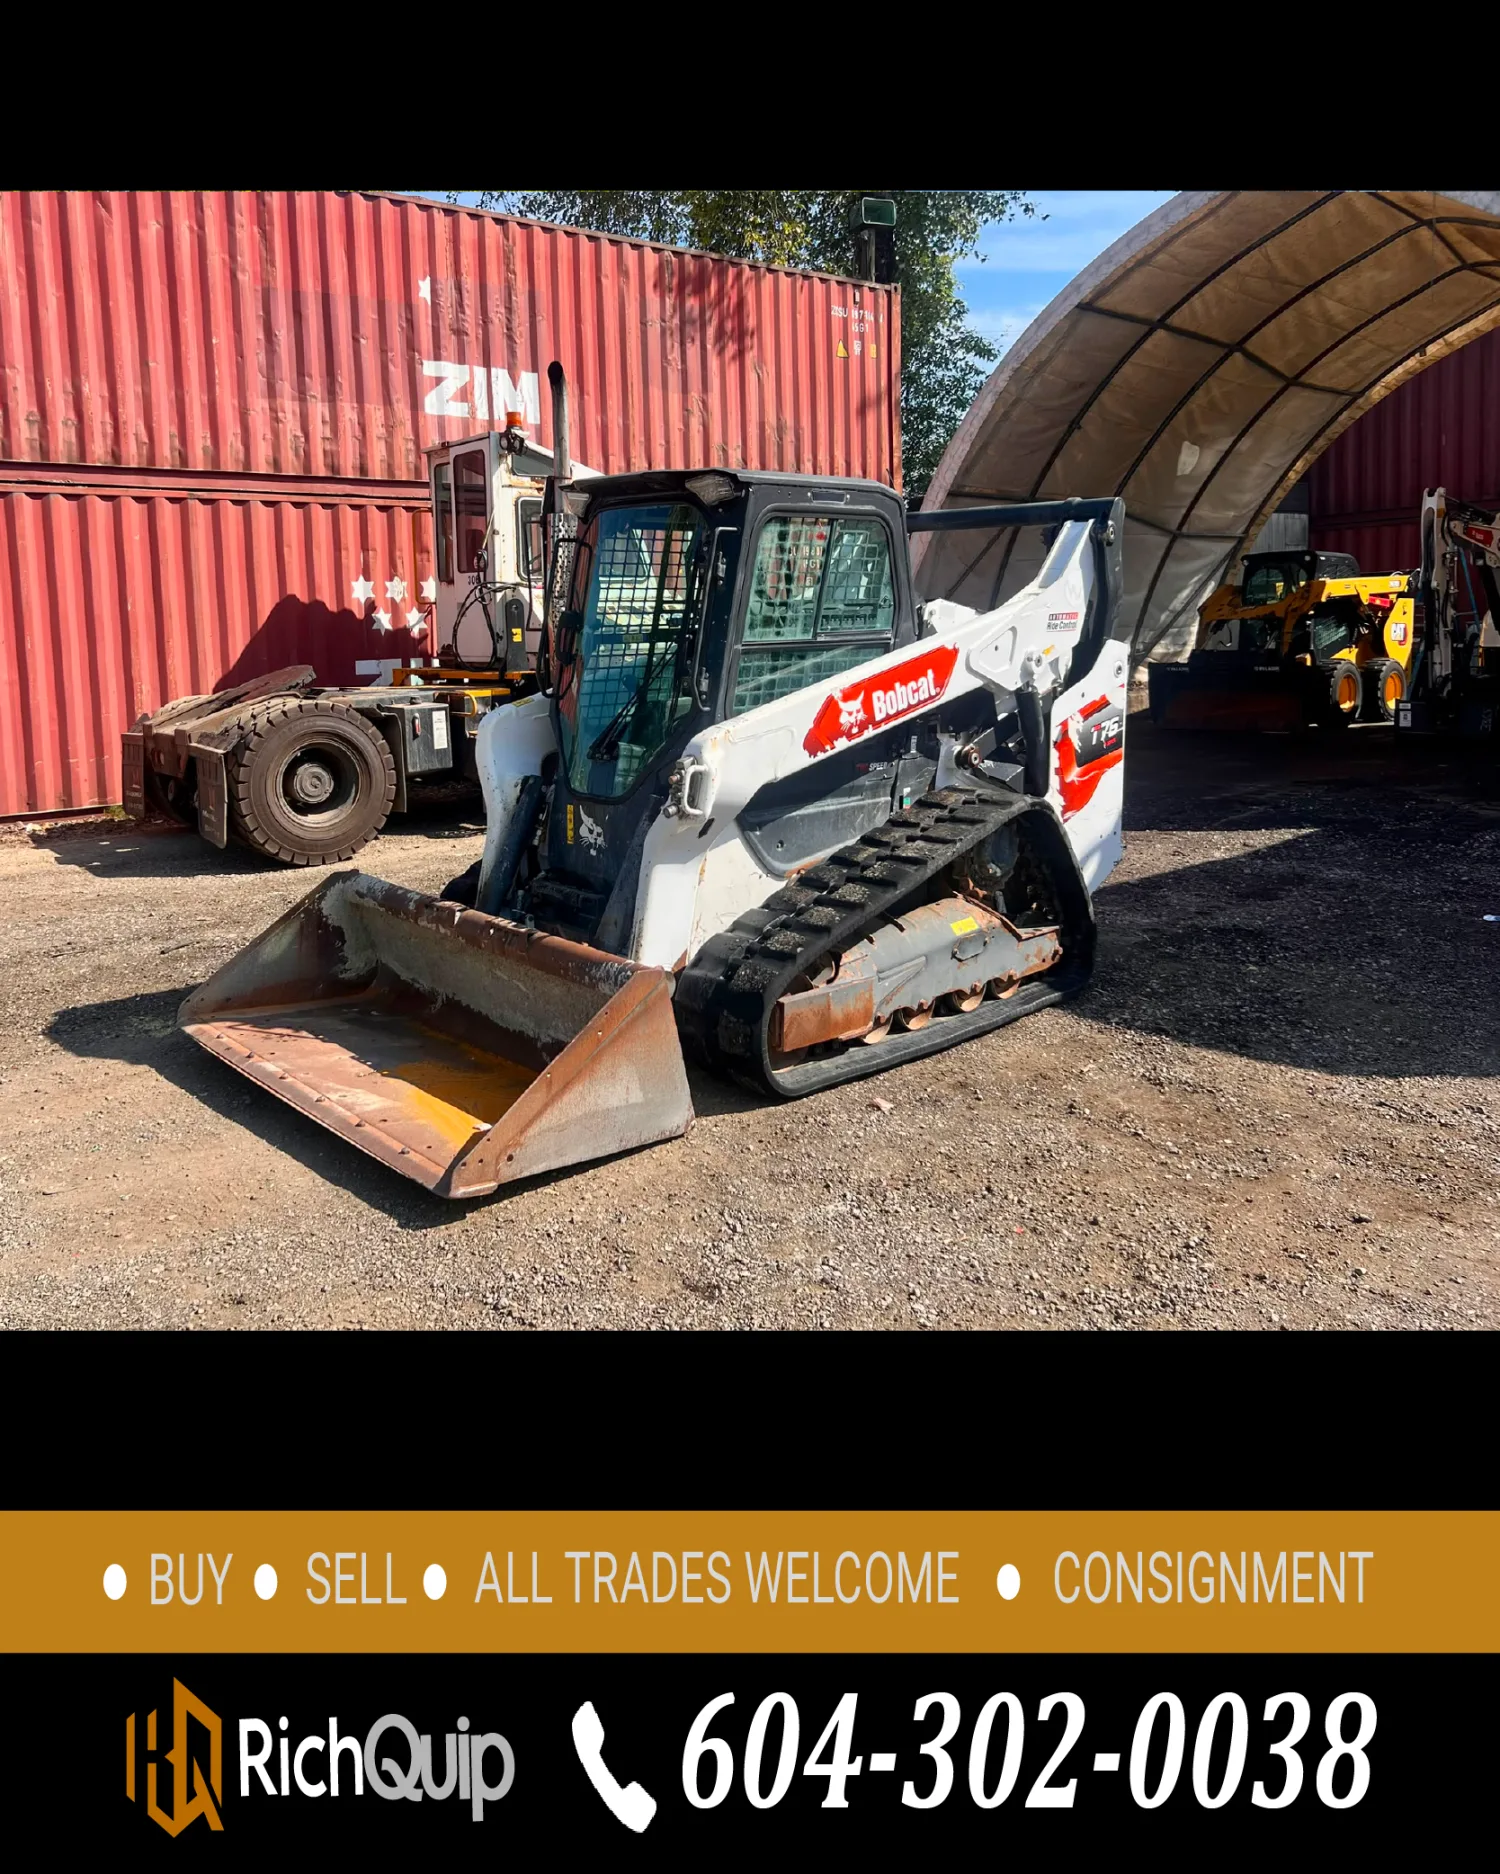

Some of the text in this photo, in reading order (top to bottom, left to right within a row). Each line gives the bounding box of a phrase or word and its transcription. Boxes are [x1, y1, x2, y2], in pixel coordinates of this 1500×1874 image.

[422, 360, 540, 424] ZIM
[872, 668, 936, 721] Bobcat
[1091, 716, 1120, 745] T76
